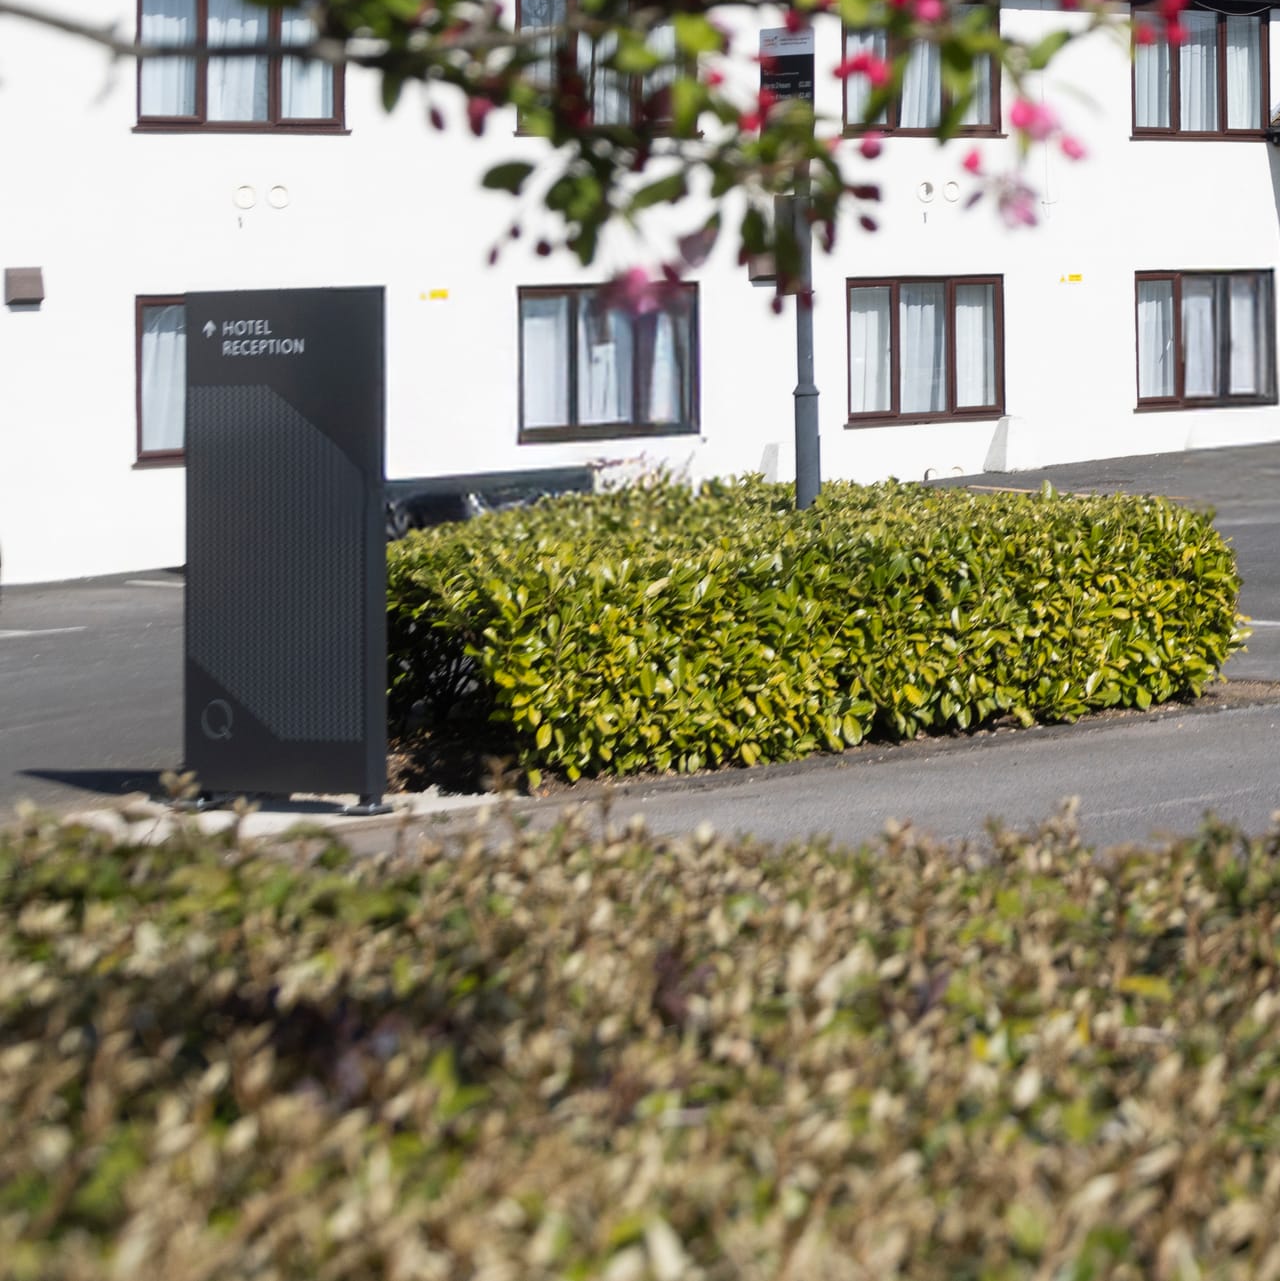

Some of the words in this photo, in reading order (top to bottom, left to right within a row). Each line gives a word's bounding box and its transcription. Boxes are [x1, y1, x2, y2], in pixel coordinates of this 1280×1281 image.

[222, 319, 273, 337] HOTEL
[222, 338, 305, 357] RECEPTION
[200, 698, 233, 740] Q
